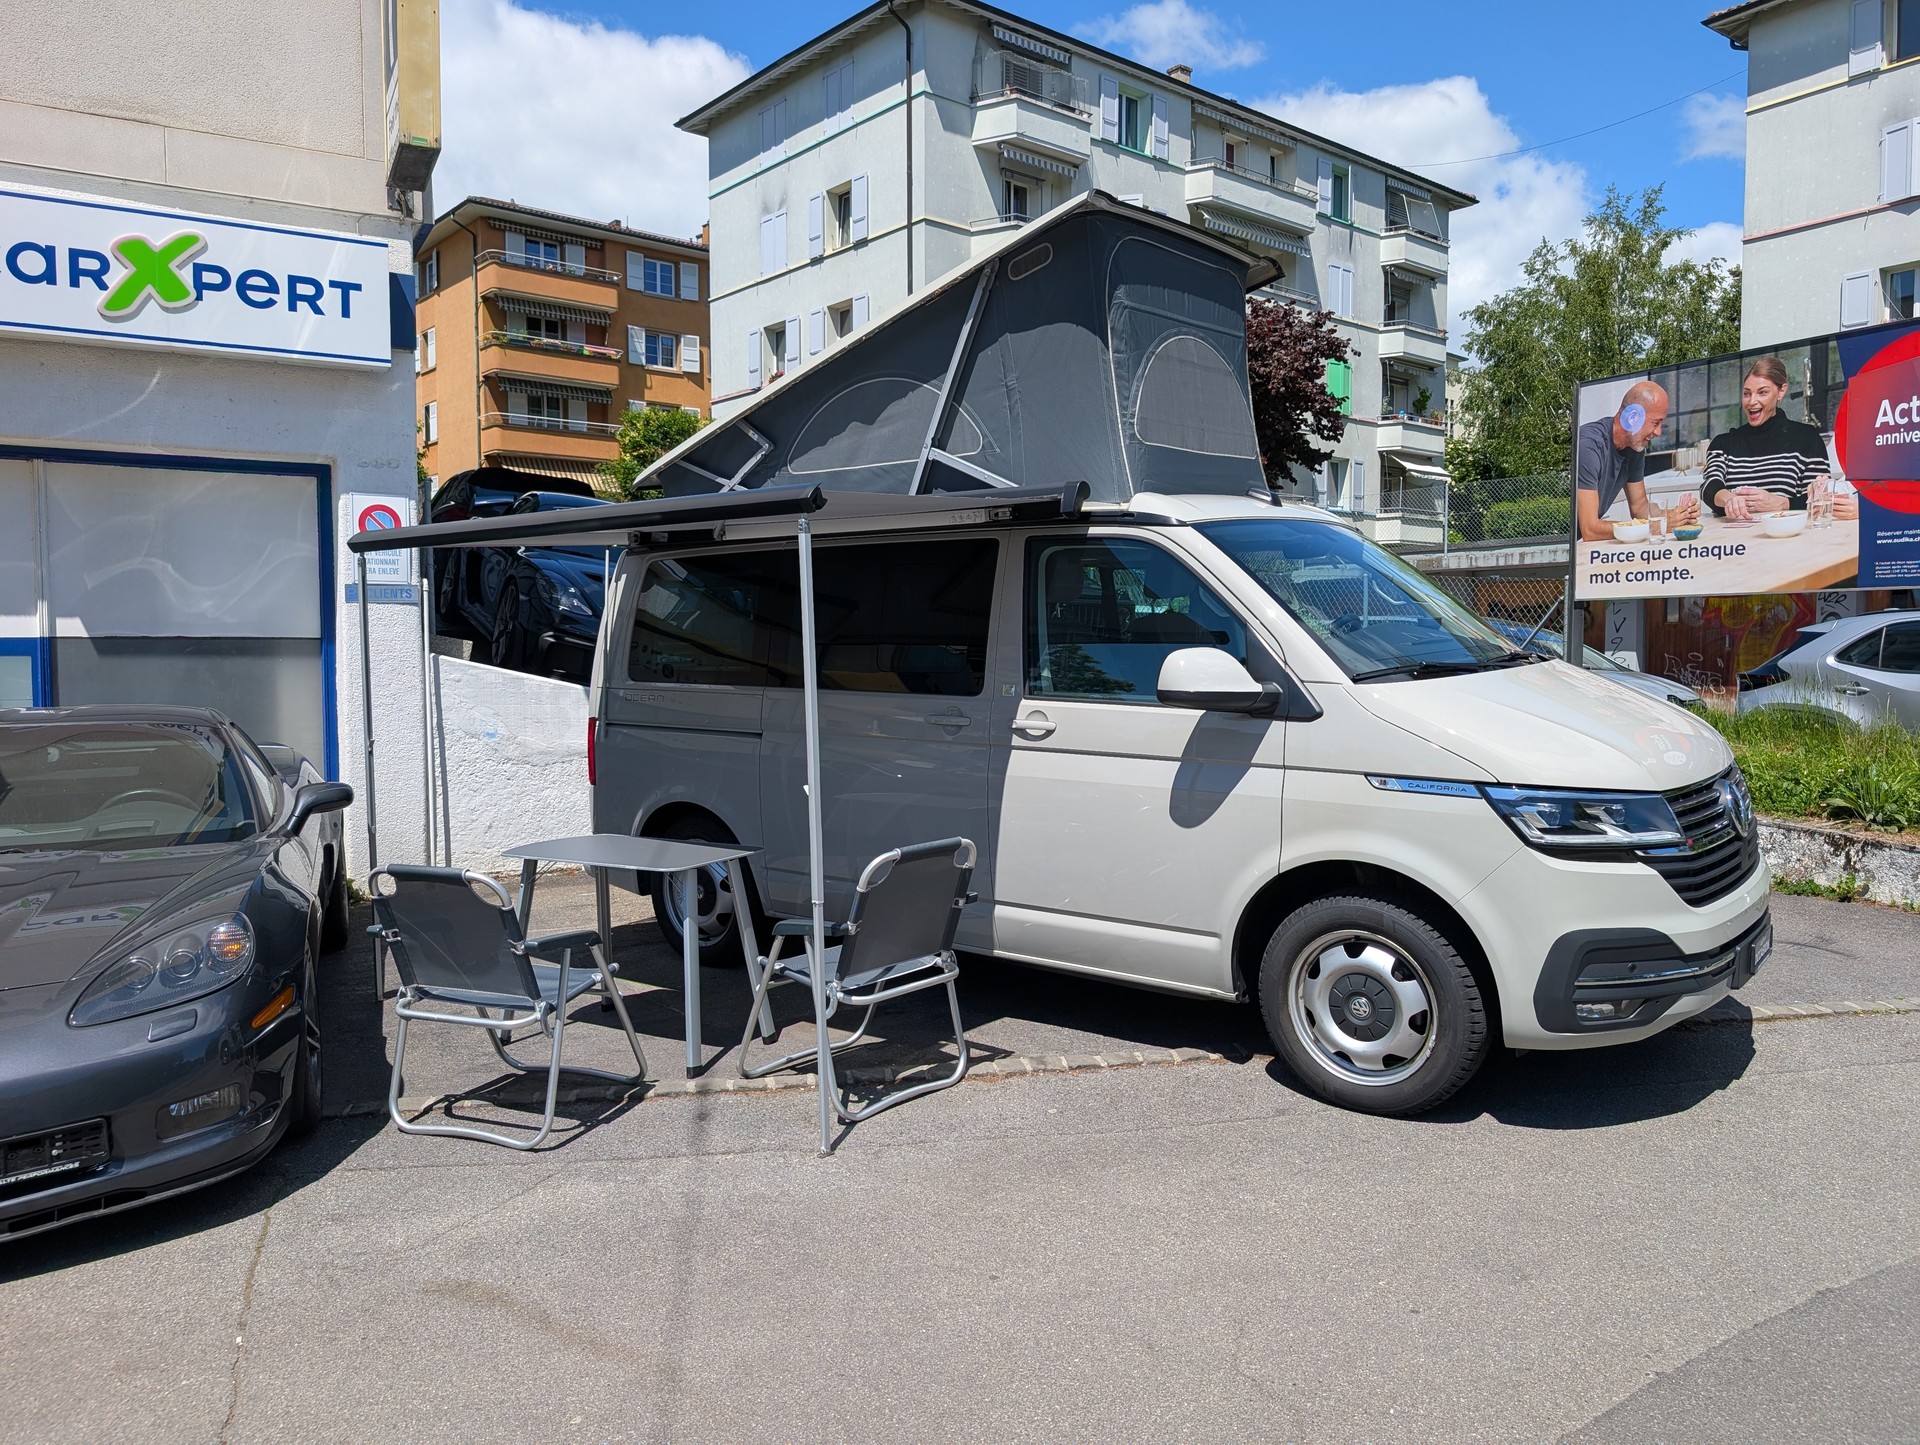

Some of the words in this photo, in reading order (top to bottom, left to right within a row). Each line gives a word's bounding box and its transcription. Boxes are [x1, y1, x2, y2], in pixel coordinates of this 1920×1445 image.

[1875, 395, 1920, 428] Act
[1875, 428, 1920, 446] annive
[367, 558, 400, 566] ATIONNANT
[1590, 550, 1635, 565] Parce
[1640, 549, 1673, 564] que
[1678, 543, 1746, 561] chaque
[1589, 569, 1621, 584] mot
[1625, 567, 1695, 585] compte.
[1407, 782, 1467, 793] CALIFORNIA
